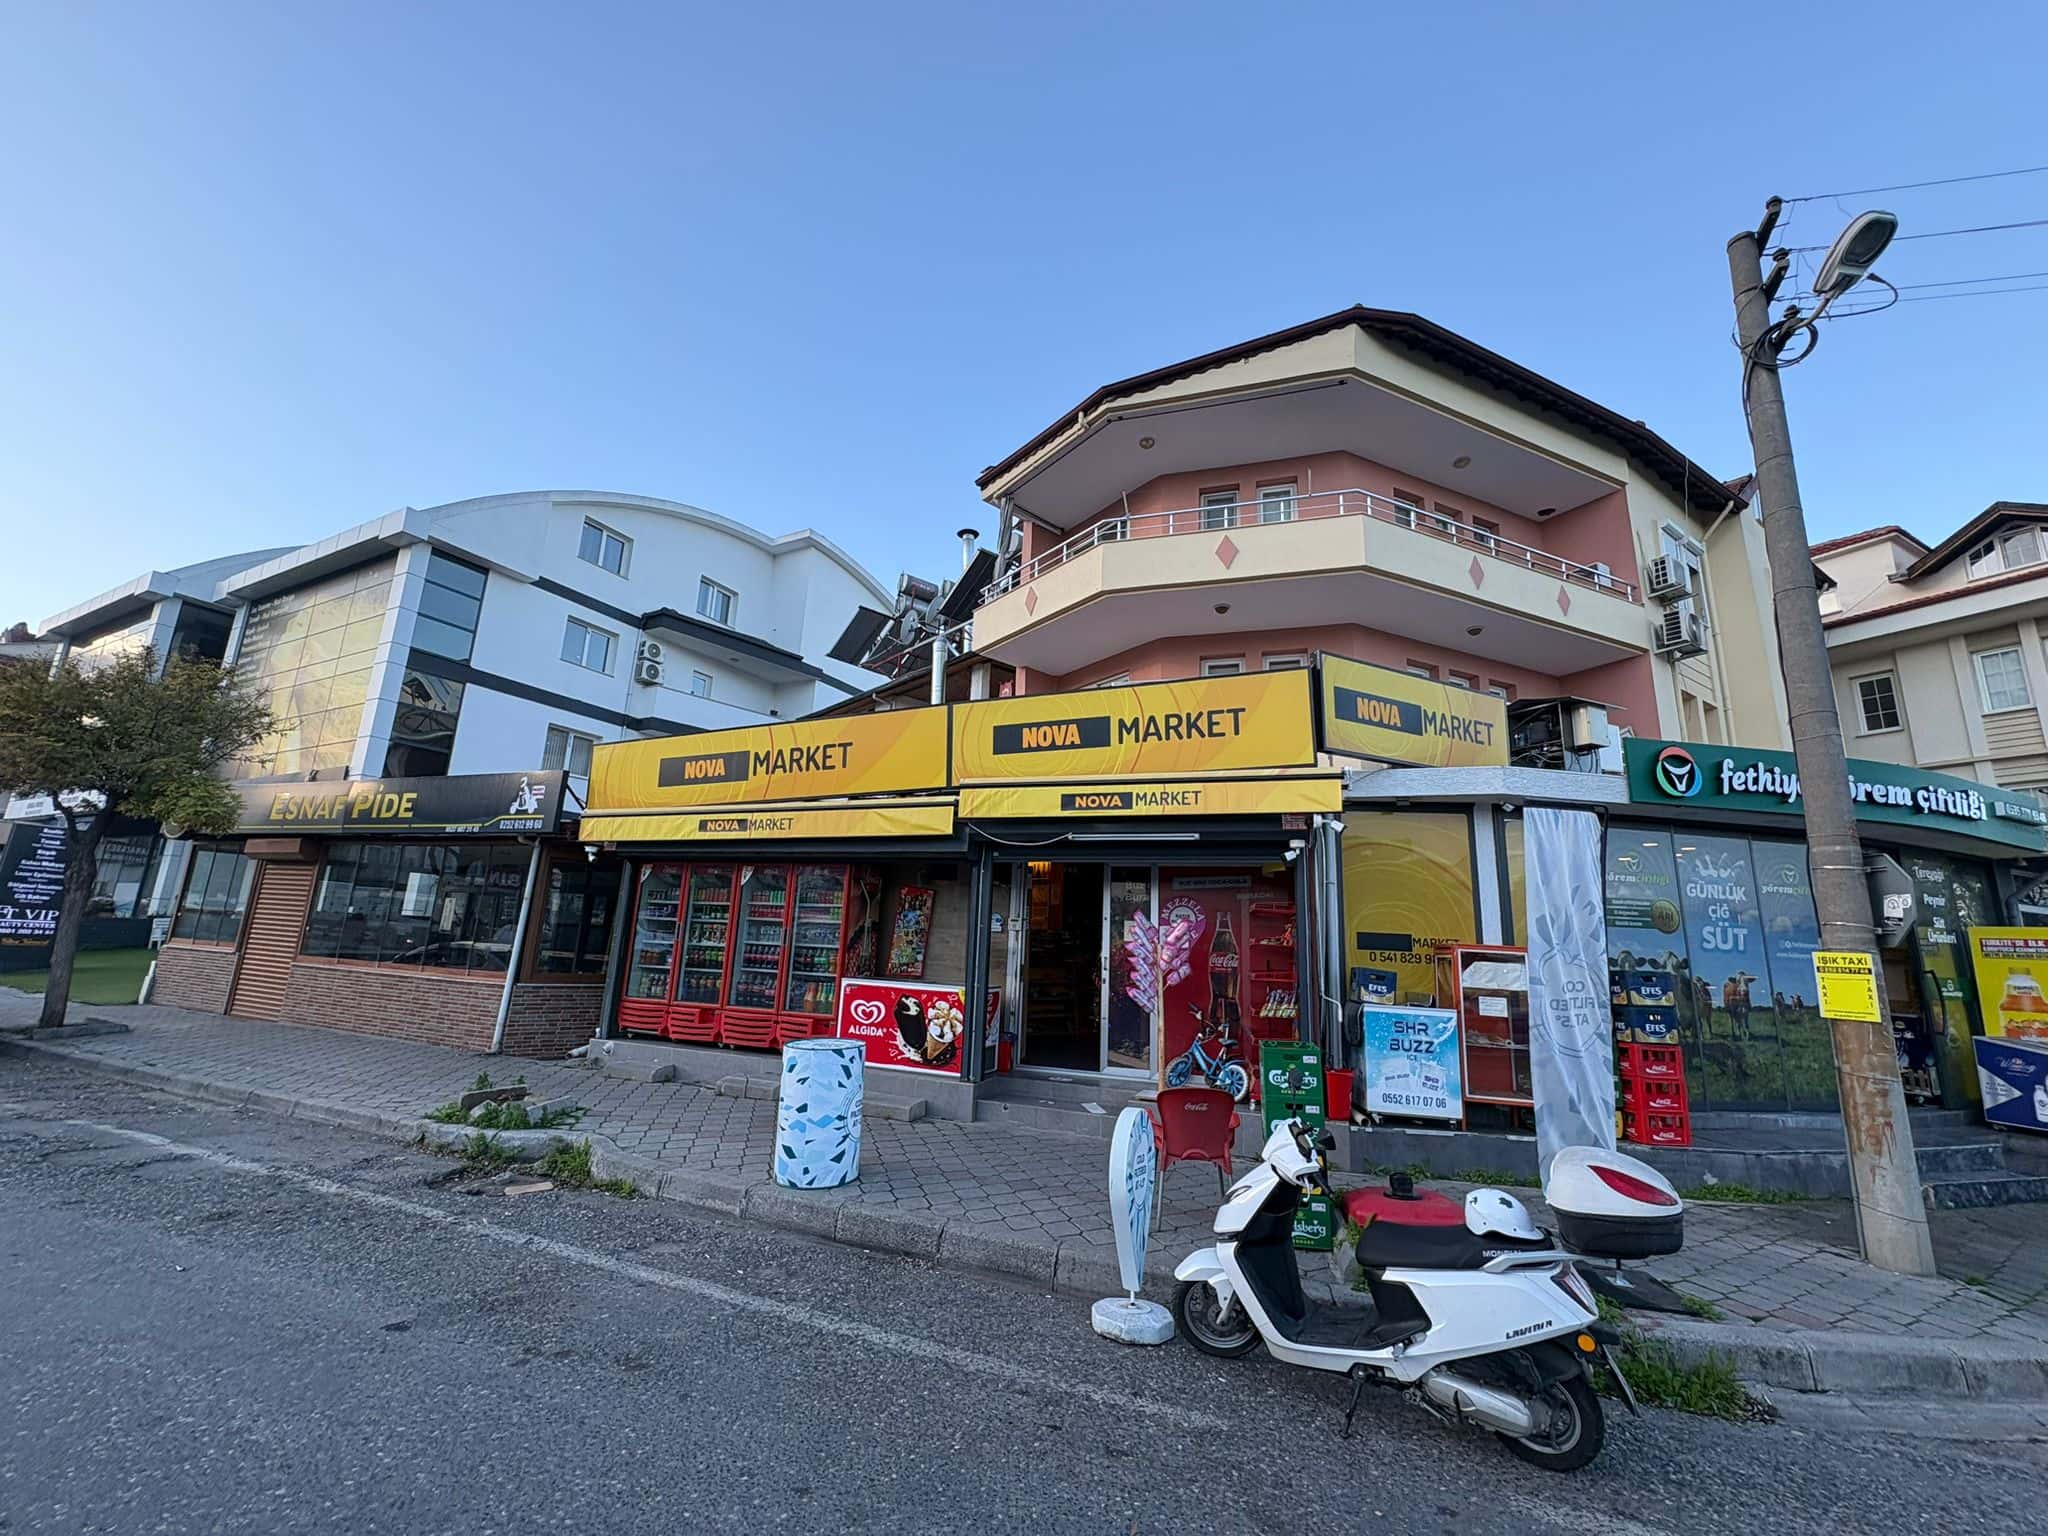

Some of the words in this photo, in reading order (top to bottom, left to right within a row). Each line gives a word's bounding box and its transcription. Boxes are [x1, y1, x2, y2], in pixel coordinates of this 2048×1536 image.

[1022, 723, 1081, 749] NOVA
[1118, 708, 1246, 745] MARKET
[1356, 697, 1402, 728] NOVA
[1423, 708, 1494, 747] MARKET
[684, 758, 726, 779] NOVA
[752, 742, 853, 777] MARKET
[269, 792, 348, 821] ESNAF
[1074, 796, 1123, 808] NOVA
[1135, 790, 1202, 808] MARKET
[1917, 784, 1987, 821] çiftliği
[706, 820, 740, 832] NOVA
[749, 818, 794, 832] MARKET
[1686, 880, 1747, 901] GÜNLÜK
[25, 909, 60, 920] VIP
[1708, 903, 1730, 920] ÇİĞ
[1702, 922, 1748, 951] SÜT
[1369, 952, 1377, 961] 0
[1379, 952, 1397, 963] 541
[1400, 953, 1422, 964] 829
[1840, 957, 1868, 966] TAXI
[1368, 983, 1388, 992] EFES
[1641, 986, 1662, 995] EFES
[1393, 1020, 1429, 1036] SHR
[1645, 1023, 1666, 1032] EFES
[1389, 1038, 1436, 1054] BUZZ
[1382, 1092, 1404, 1105] 0552
[1423, 1096, 1434, 1108] 07
[1435, 1097, 1447, 1109] 06
[1292, 1220, 1326, 1237] lsberg
